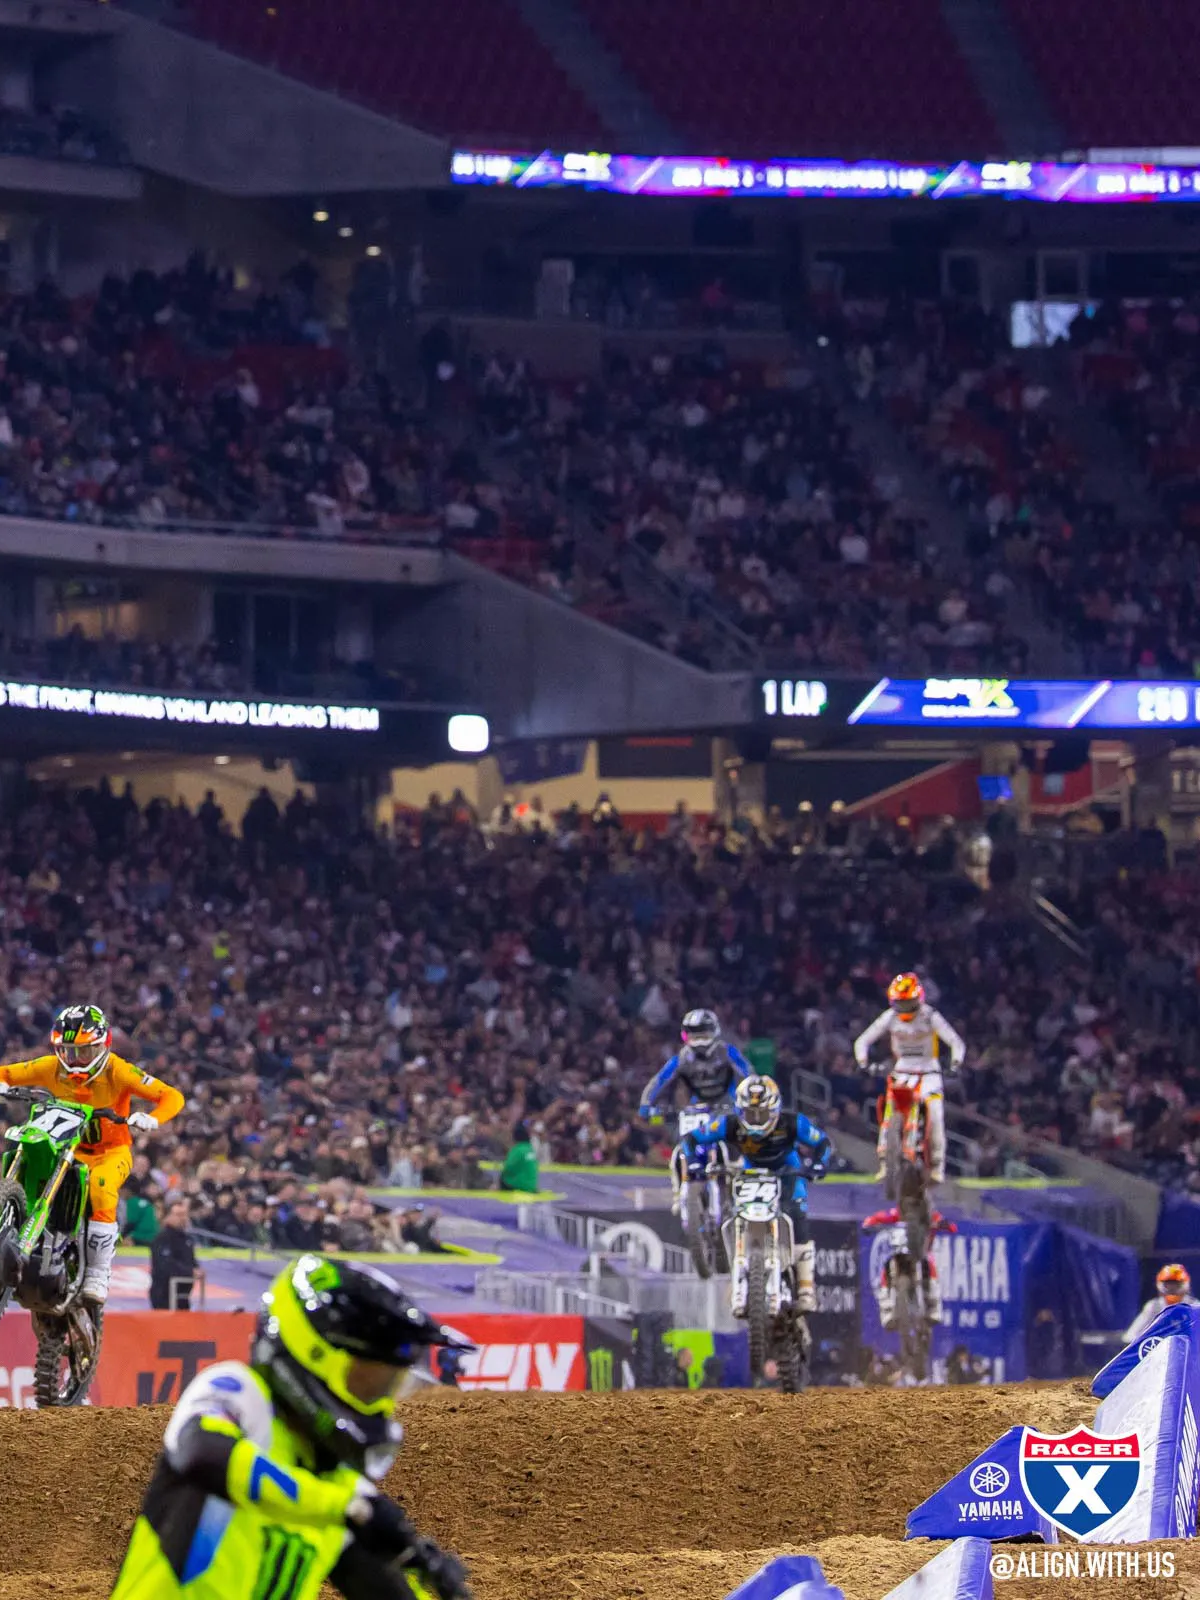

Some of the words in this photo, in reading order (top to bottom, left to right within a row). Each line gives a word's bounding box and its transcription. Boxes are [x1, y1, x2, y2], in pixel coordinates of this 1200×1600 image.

[7, 683, 38, 707] THE
[249, 703, 326, 728] LEADING
[762, 680, 777, 716] 1
[781, 680, 827, 716] LAP
[30, 1108, 84, 1139] 47
[737, 1182, 778, 1203] 34
[958, 1500, 1024, 1517] YAMAHA
